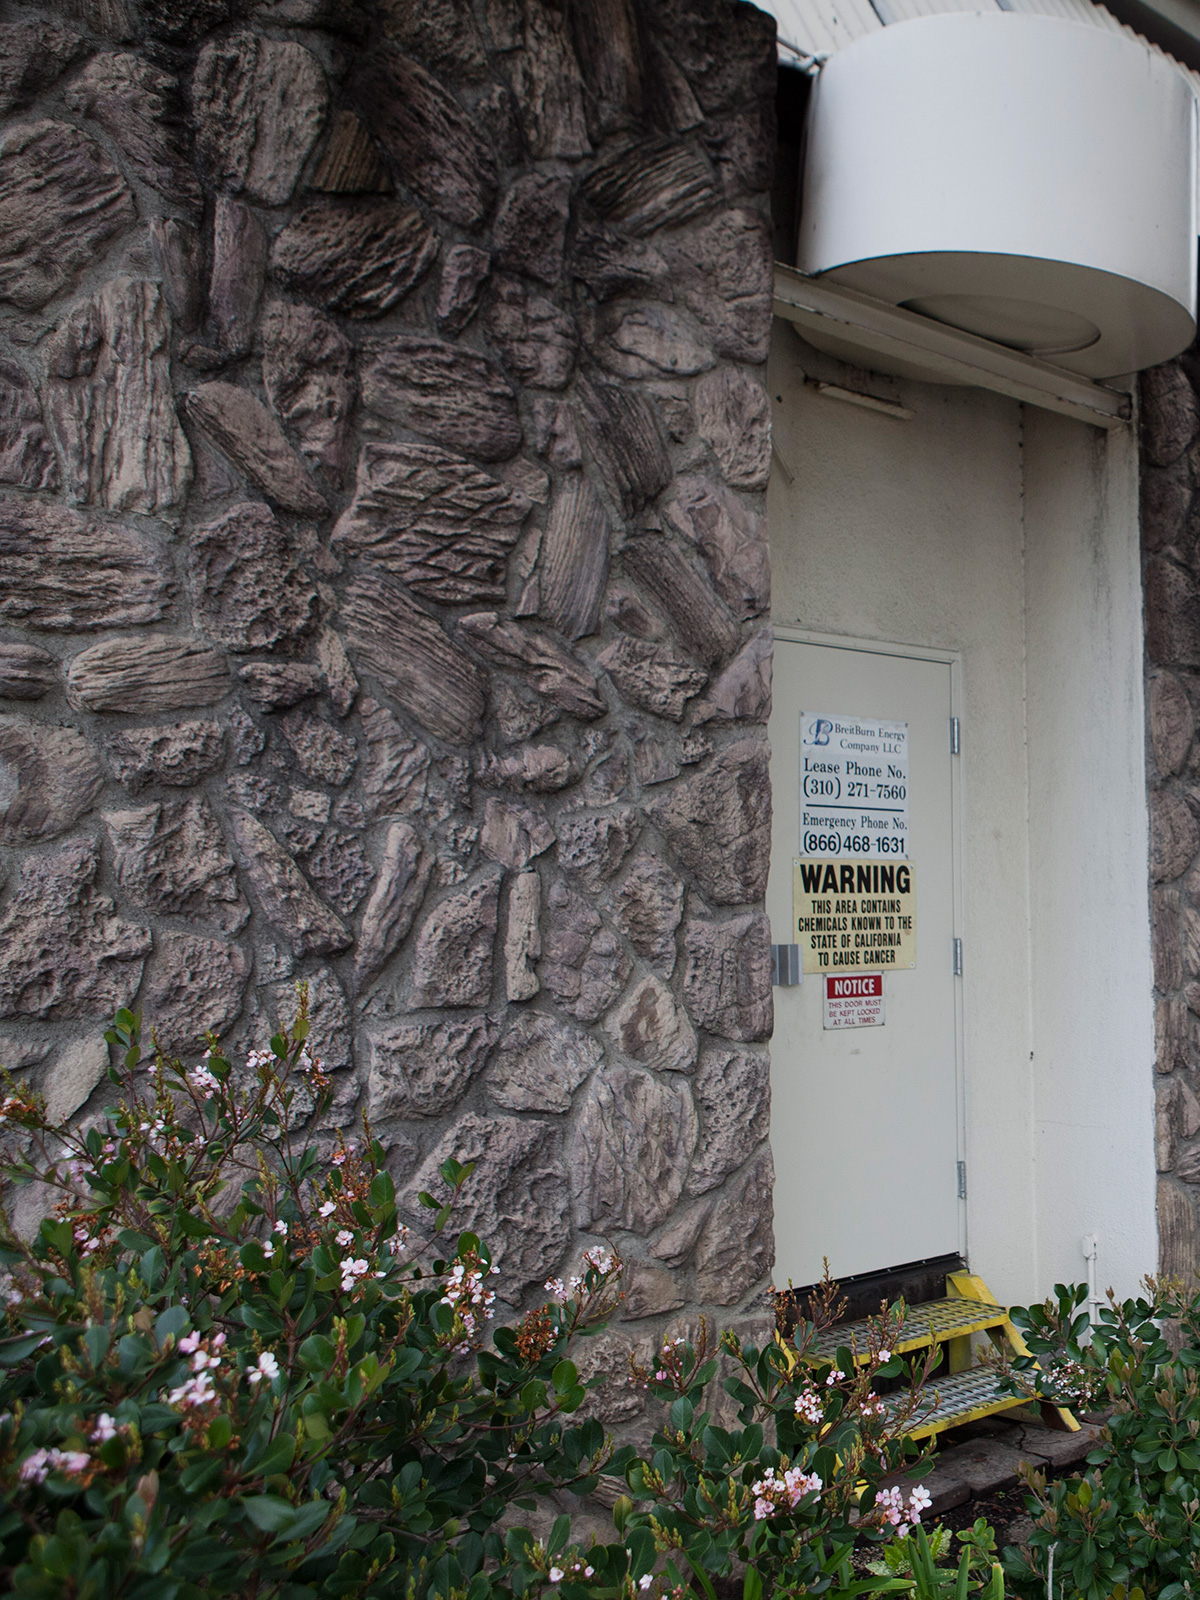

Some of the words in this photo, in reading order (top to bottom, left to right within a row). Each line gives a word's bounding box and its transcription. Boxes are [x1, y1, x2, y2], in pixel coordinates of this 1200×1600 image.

[834, 723, 875, 737] BreitBurn
[878, 727, 906, 742] Energy
[840, 738, 880, 754] Company
[883, 742, 902, 754] LLC
[804, 757, 840, 774] Lease
[846, 760, 882, 777] Phone
[887, 764, 906, 779] No.
[803, 774, 841, 800] (310)
[847, 781, 907, 800] 271-7560
[802, 812, 857, 830] Emergency
[860, 815, 889, 829] Phone
[892, 817, 908, 830] No.
[800, 864, 910, 894] WARNING
[811, 900, 831, 914] THIS
[835, 899, 857, 913] AREA
[861, 899, 901, 914] CONTAINS
[798, 917, 848, 932] CHEMICALS
[851, 917, 881, 931] KNOWN
[884, 916, 895, 930] TO
[897, 916, 912, 930] THE
[810, 934, 838, 949] STATE
[841, 934, 851, 948] OF
[854, 933, 901, 948] CALIFORNIA
[818, 951, 829, 967] TO
[832, 951, 860, 966] CAUSE
[863, 949, 895, 964] CANCER
[834, 978, 875, 996] NOTICE
[828, 1001, 842, 1009] THIS
[844, 1000, 863, 1008] DOOR
[865, 999, 881, 1007] MUST
[840, 1009, 855, 1017] KEPT
[857, 1008, 881, 1016] LOCKED
[858, 1016, 876, 1024] TIMES
